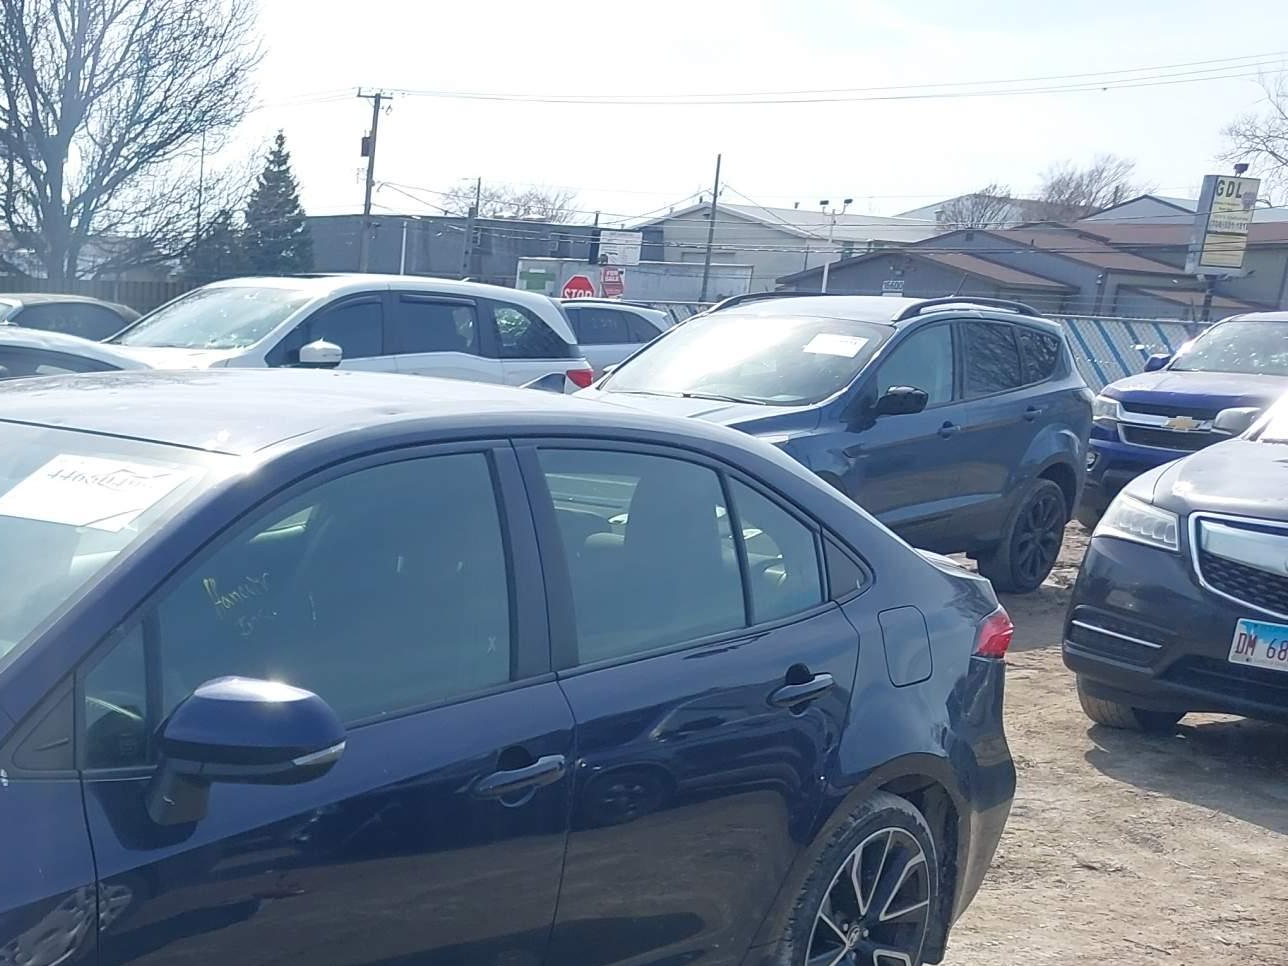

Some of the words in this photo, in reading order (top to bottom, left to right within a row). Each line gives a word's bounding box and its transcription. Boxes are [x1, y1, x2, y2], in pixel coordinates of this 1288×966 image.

[1216, 180, 1242, 198] GDL
[564, 288, 592, 298] STOP
[1235, 633, 1257, 656] DM
